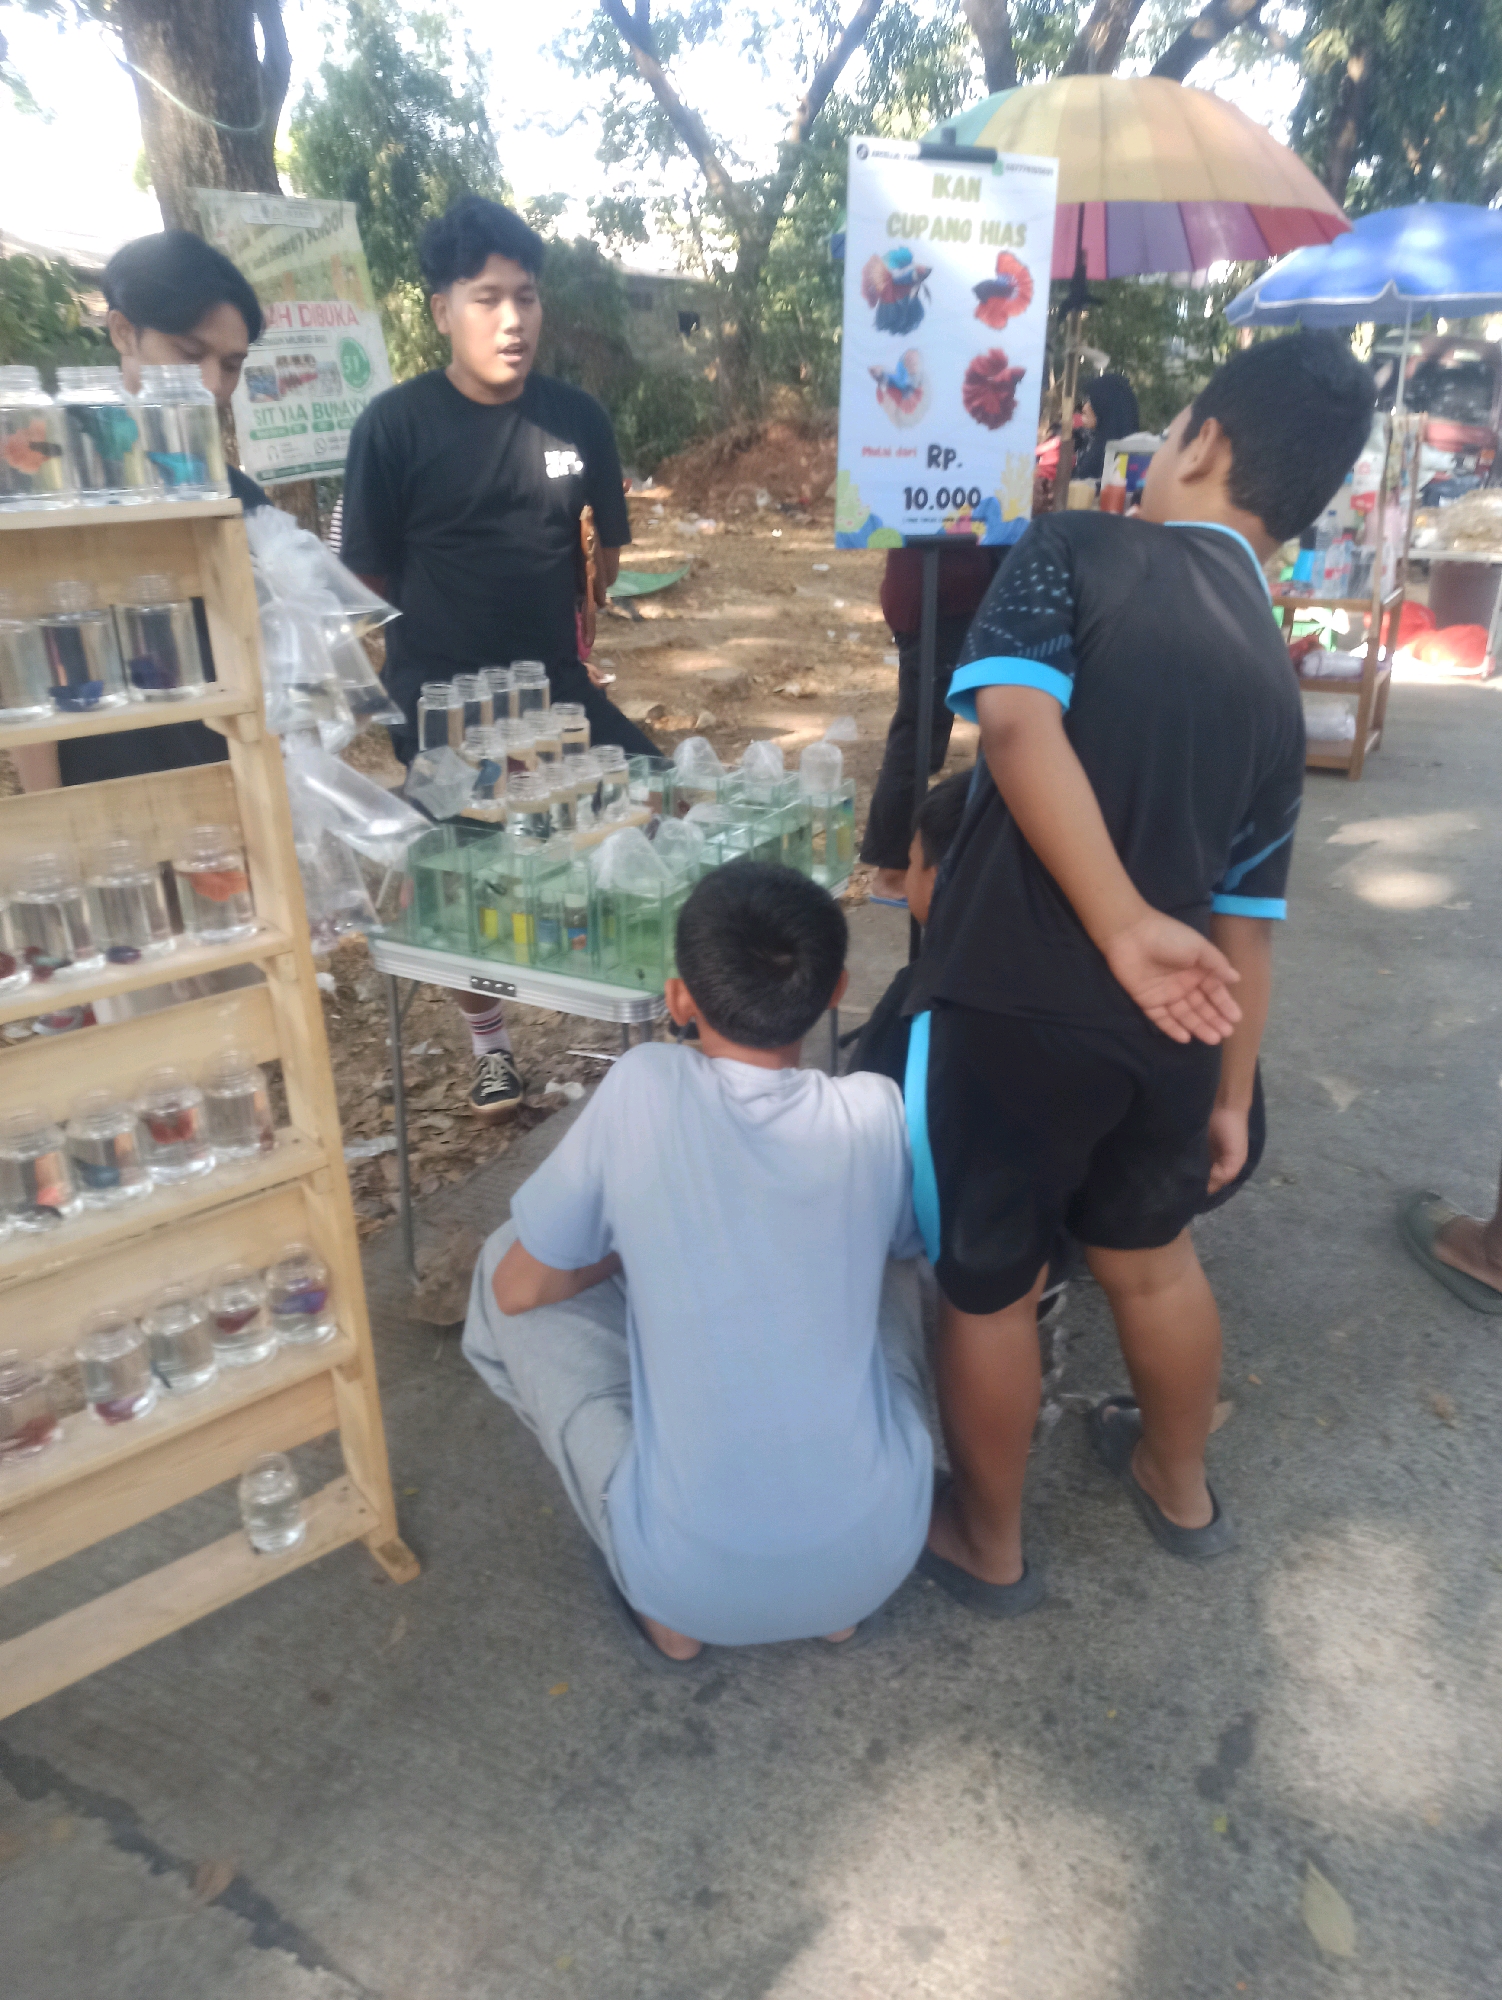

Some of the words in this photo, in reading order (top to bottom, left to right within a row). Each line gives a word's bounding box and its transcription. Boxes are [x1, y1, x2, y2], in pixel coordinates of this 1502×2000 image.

[932, 173, 983, 203] IKAN
[979, 219, 1028, 248] HIAS
[297, 302, 360, 328] DIBUKA
[904, 486, 982, 511] 10.000
